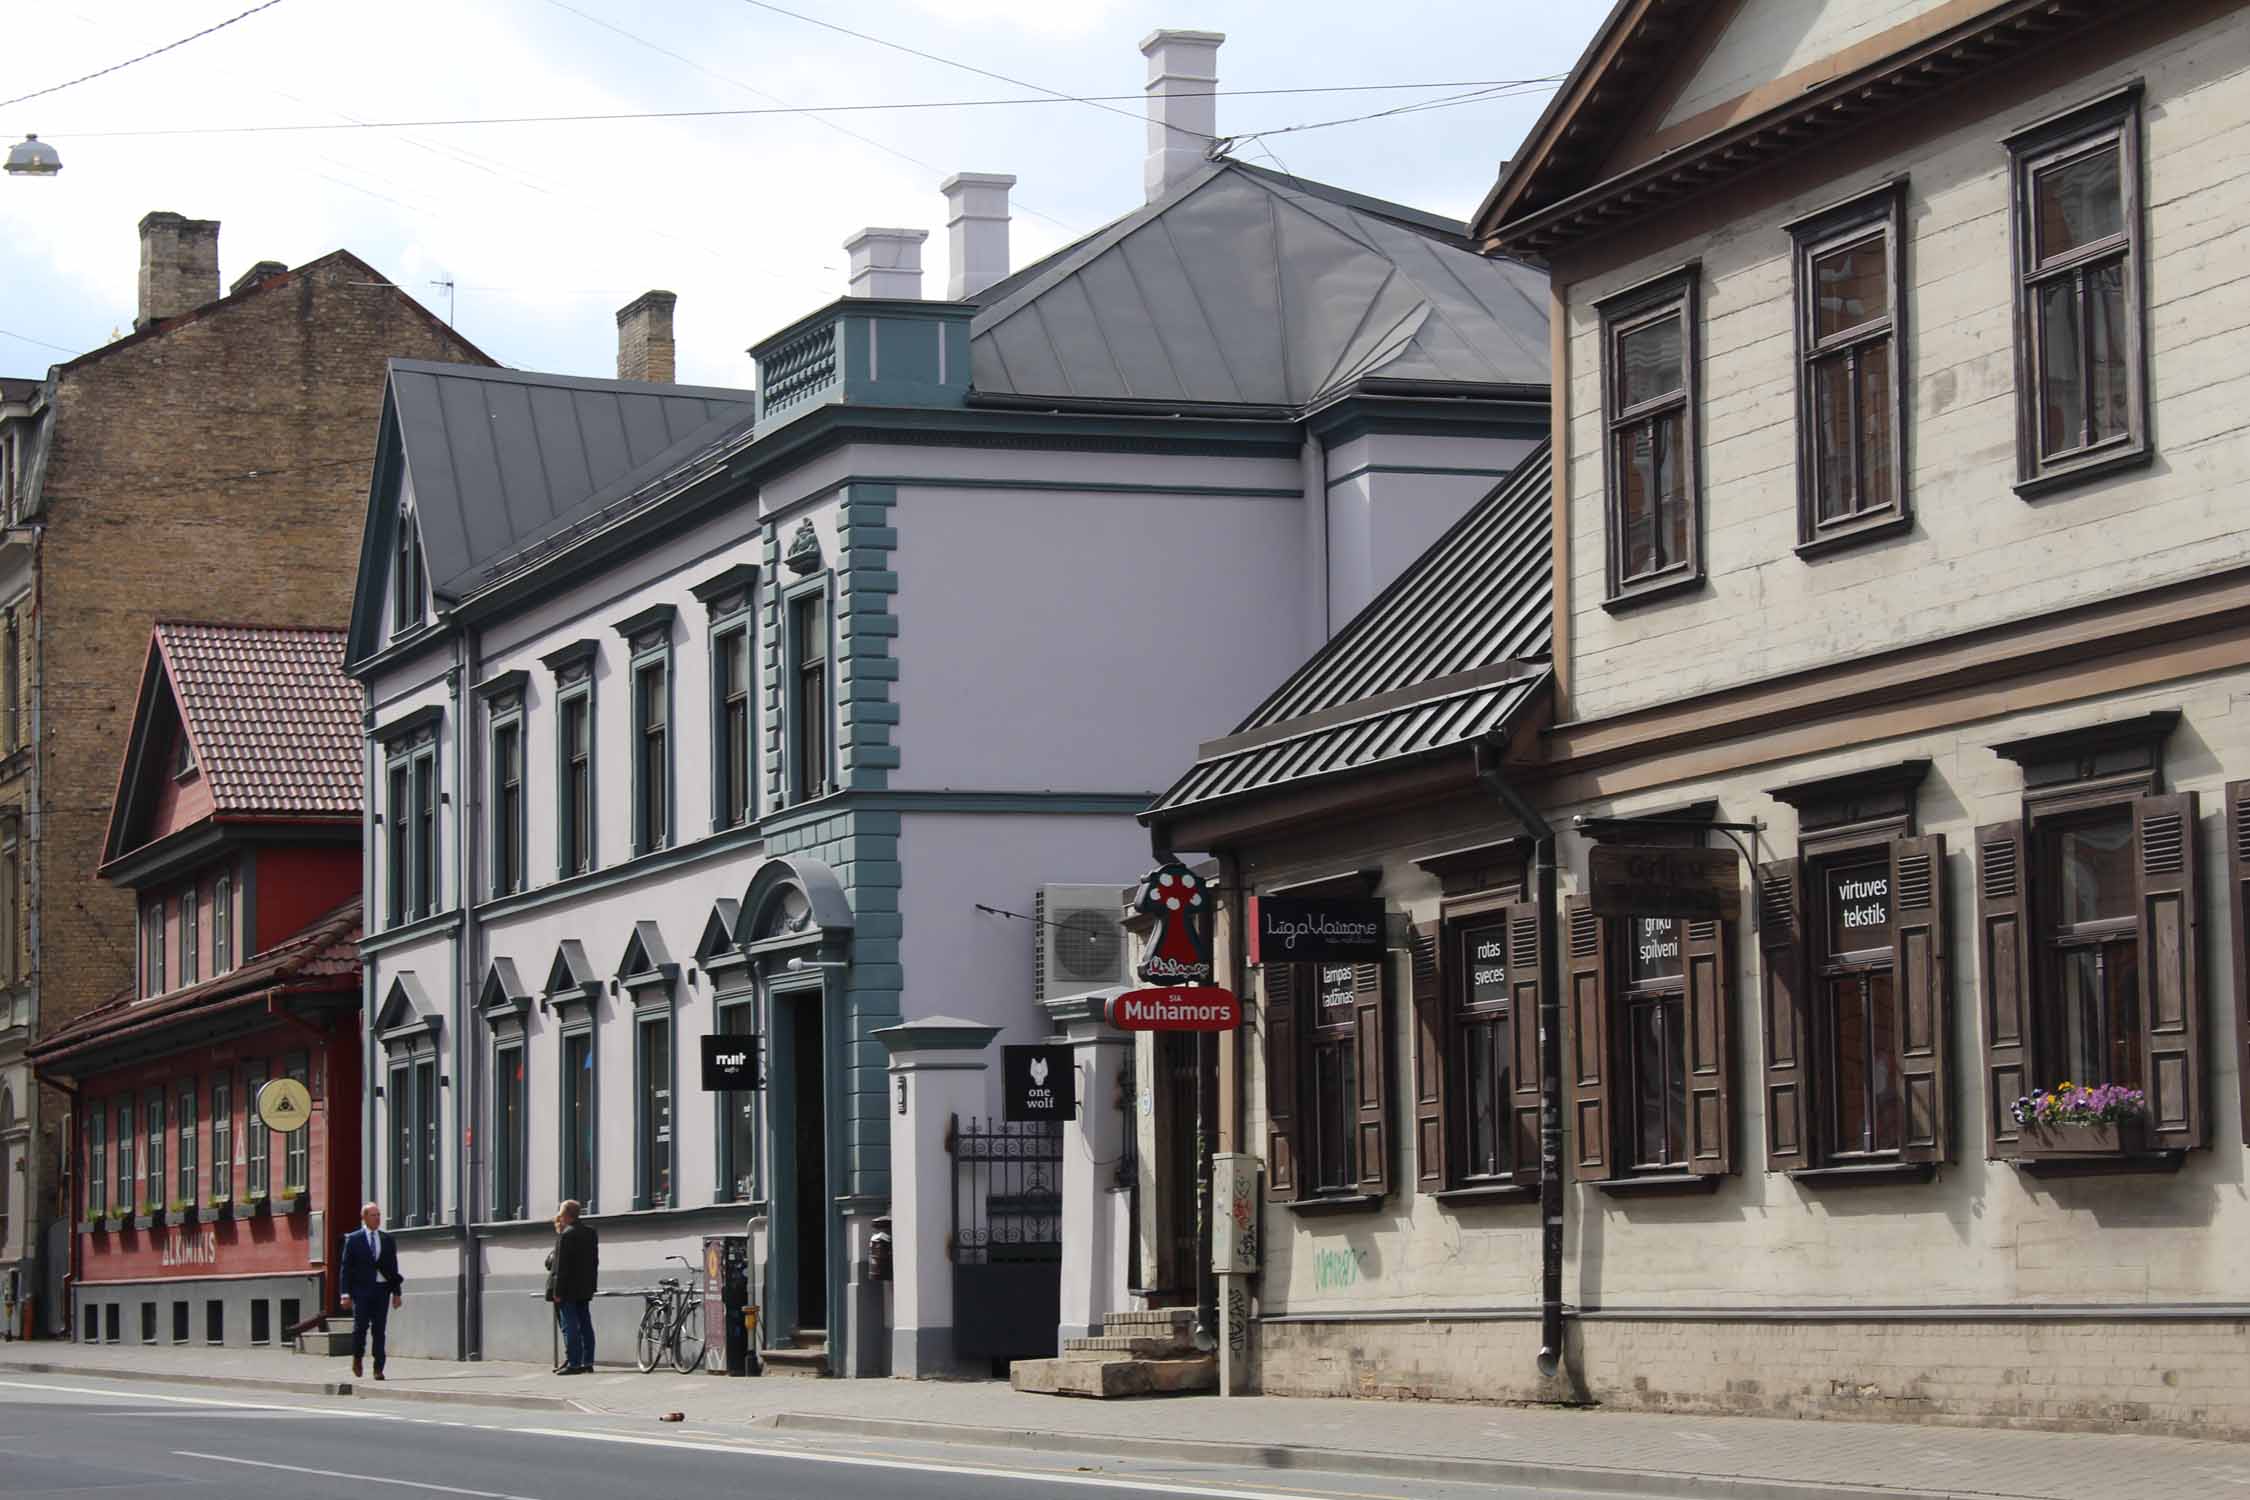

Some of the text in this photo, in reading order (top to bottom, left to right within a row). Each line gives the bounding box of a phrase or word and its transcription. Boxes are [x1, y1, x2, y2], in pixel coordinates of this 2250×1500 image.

[1839, 879, 1888, 900] virtuves
[1843, 902, 1886, 928] tekstils
[1477, 940, 1501, 959] rotas
[1639, 936, 1678, 964] spilveni
[1323, 966, 1352, 986] lampas
[1474, 968, 1504, 985] sveces
[1124, 1001, 1231, 1020] Muhamors
[1028, 1088, 1051, 1097] one
[1026, 1097, 1055, 1109] wolf
